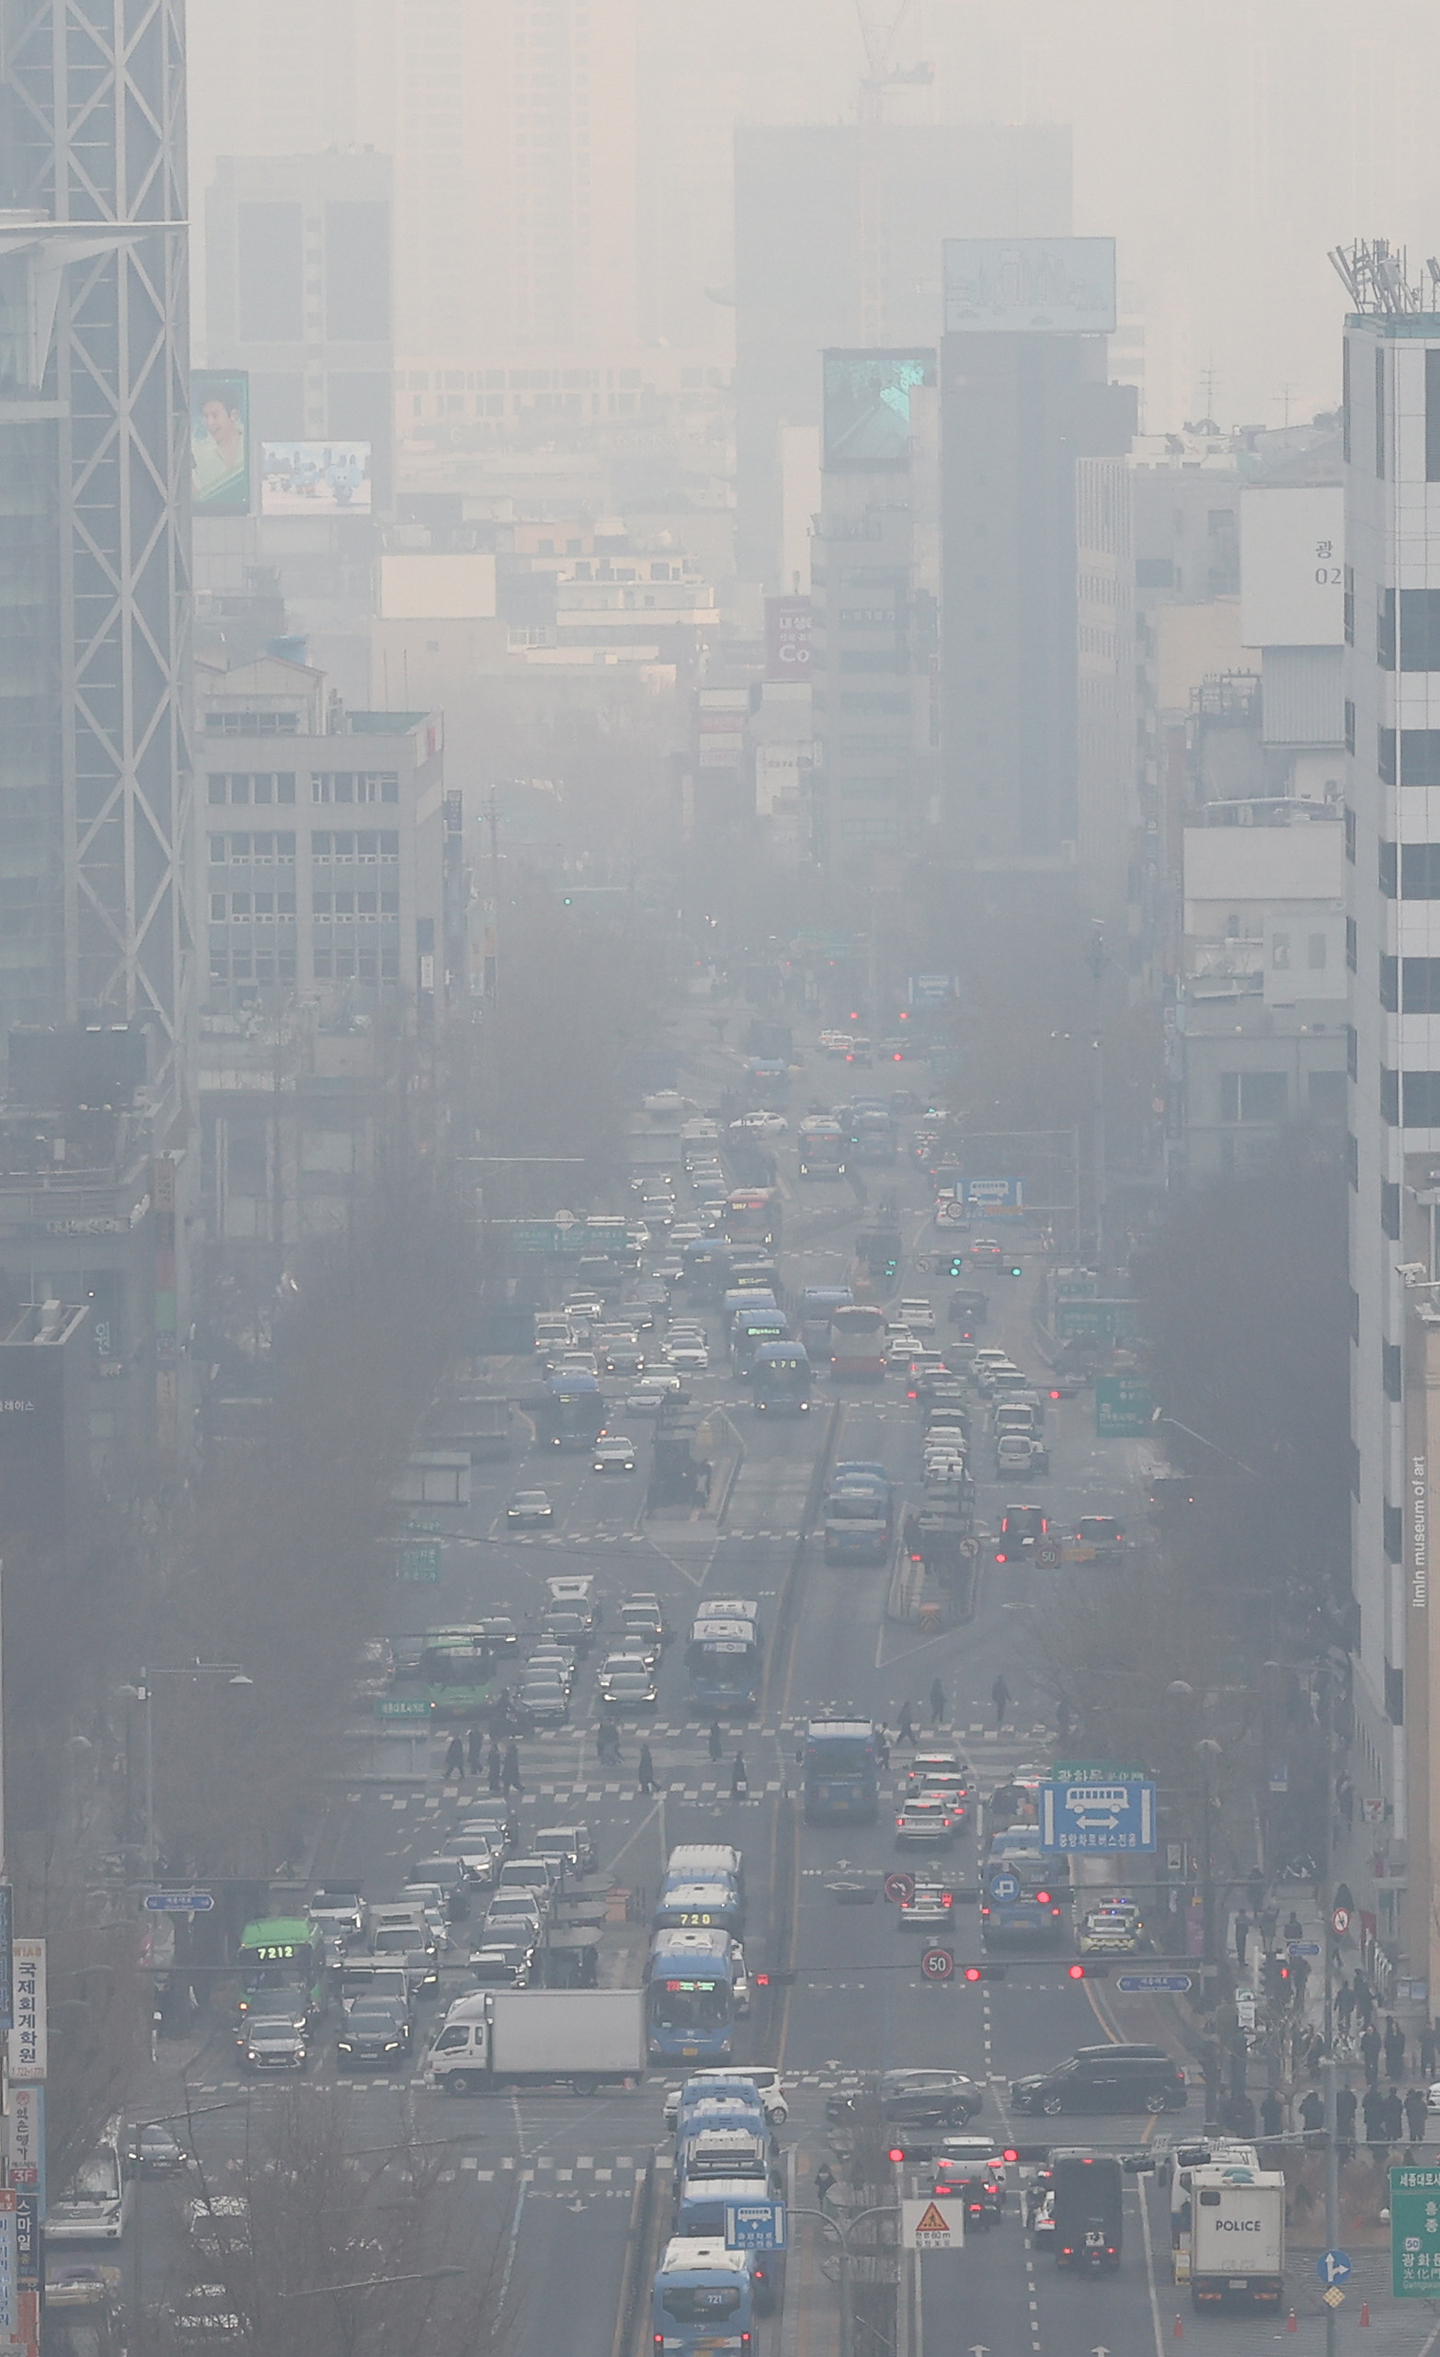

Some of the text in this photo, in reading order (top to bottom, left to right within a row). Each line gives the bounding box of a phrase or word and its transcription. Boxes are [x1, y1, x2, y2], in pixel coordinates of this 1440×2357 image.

[1315, 540, 1332, 559] 광
[0, 1400, 35, 1412] 레이스
[1411, 1456, 1425, 1608] ilmin museum of art
[1041, 1551, 1056, 1562] 50
[257, 1946, 294, 1960] 7212
[929, 1957, 947, 1972] 50
[18, 1962, 37, 2064] 국제회계학원
[13, 2169, 34, 2183] 3F
[16, 2200, 32, 2251] 스마일
[1215, 2220, 1261, 2231] POLICE
[1406, 2240, 1419, 2248] 50
